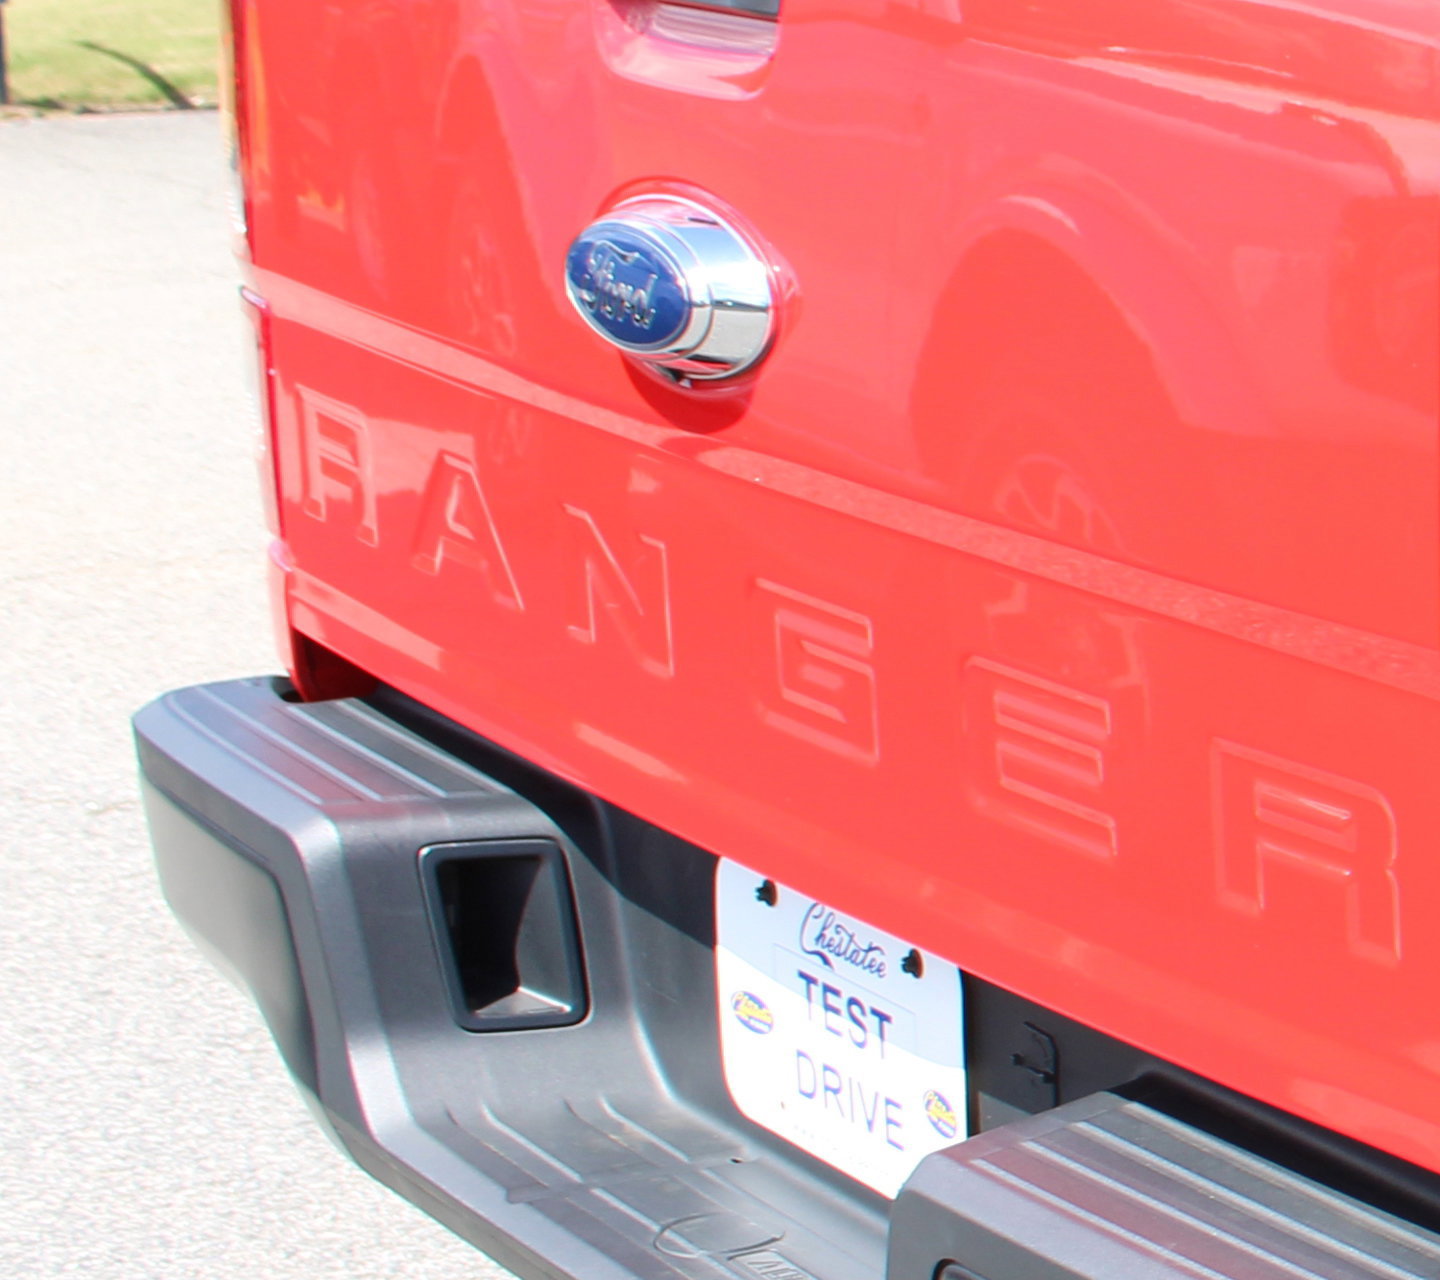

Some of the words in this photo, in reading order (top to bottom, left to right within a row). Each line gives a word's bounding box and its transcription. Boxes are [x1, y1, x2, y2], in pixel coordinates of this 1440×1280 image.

[579, 238, 659, 329] Ford
[295, 382, 1402, 968] RANGER
[800, 902, 887, 978] Chestatee
[796, 968, 893, 1059] TEST
[796, 1048, 905, 1151] DRIVE
